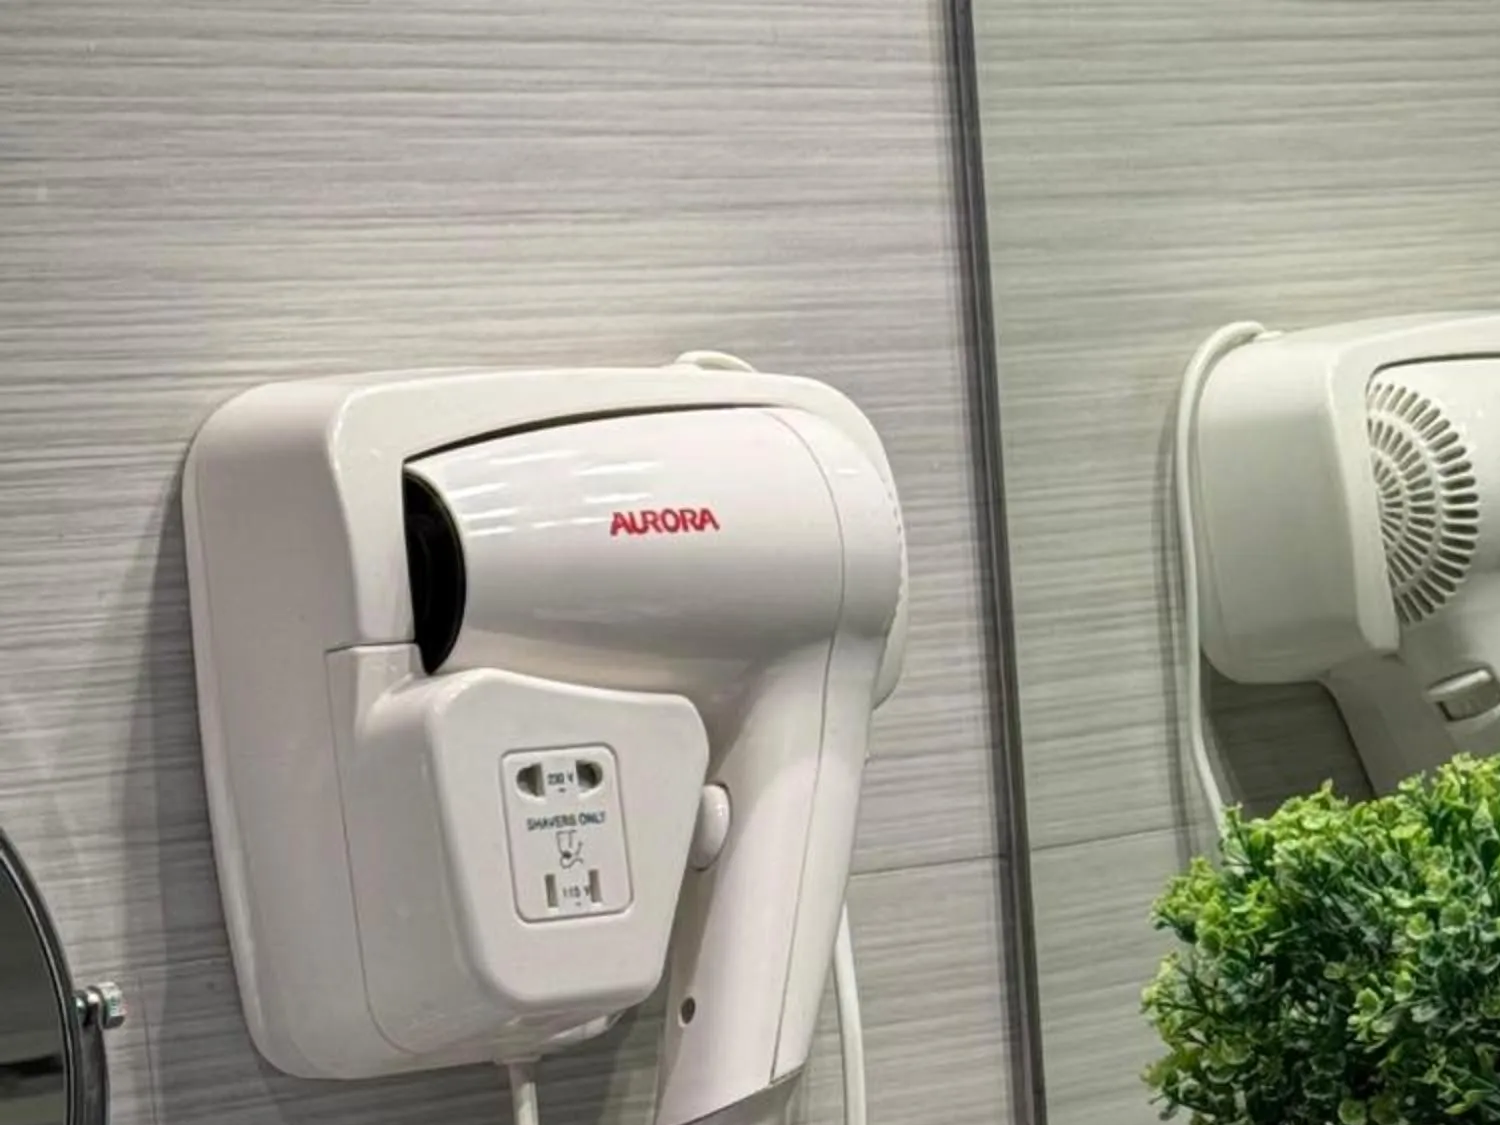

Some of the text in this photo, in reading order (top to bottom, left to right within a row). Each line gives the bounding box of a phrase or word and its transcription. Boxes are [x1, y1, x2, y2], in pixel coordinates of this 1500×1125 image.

[610, 507, 720, 536] AURORA
[526, 810, 606, 832] SHAVERS ONLY
